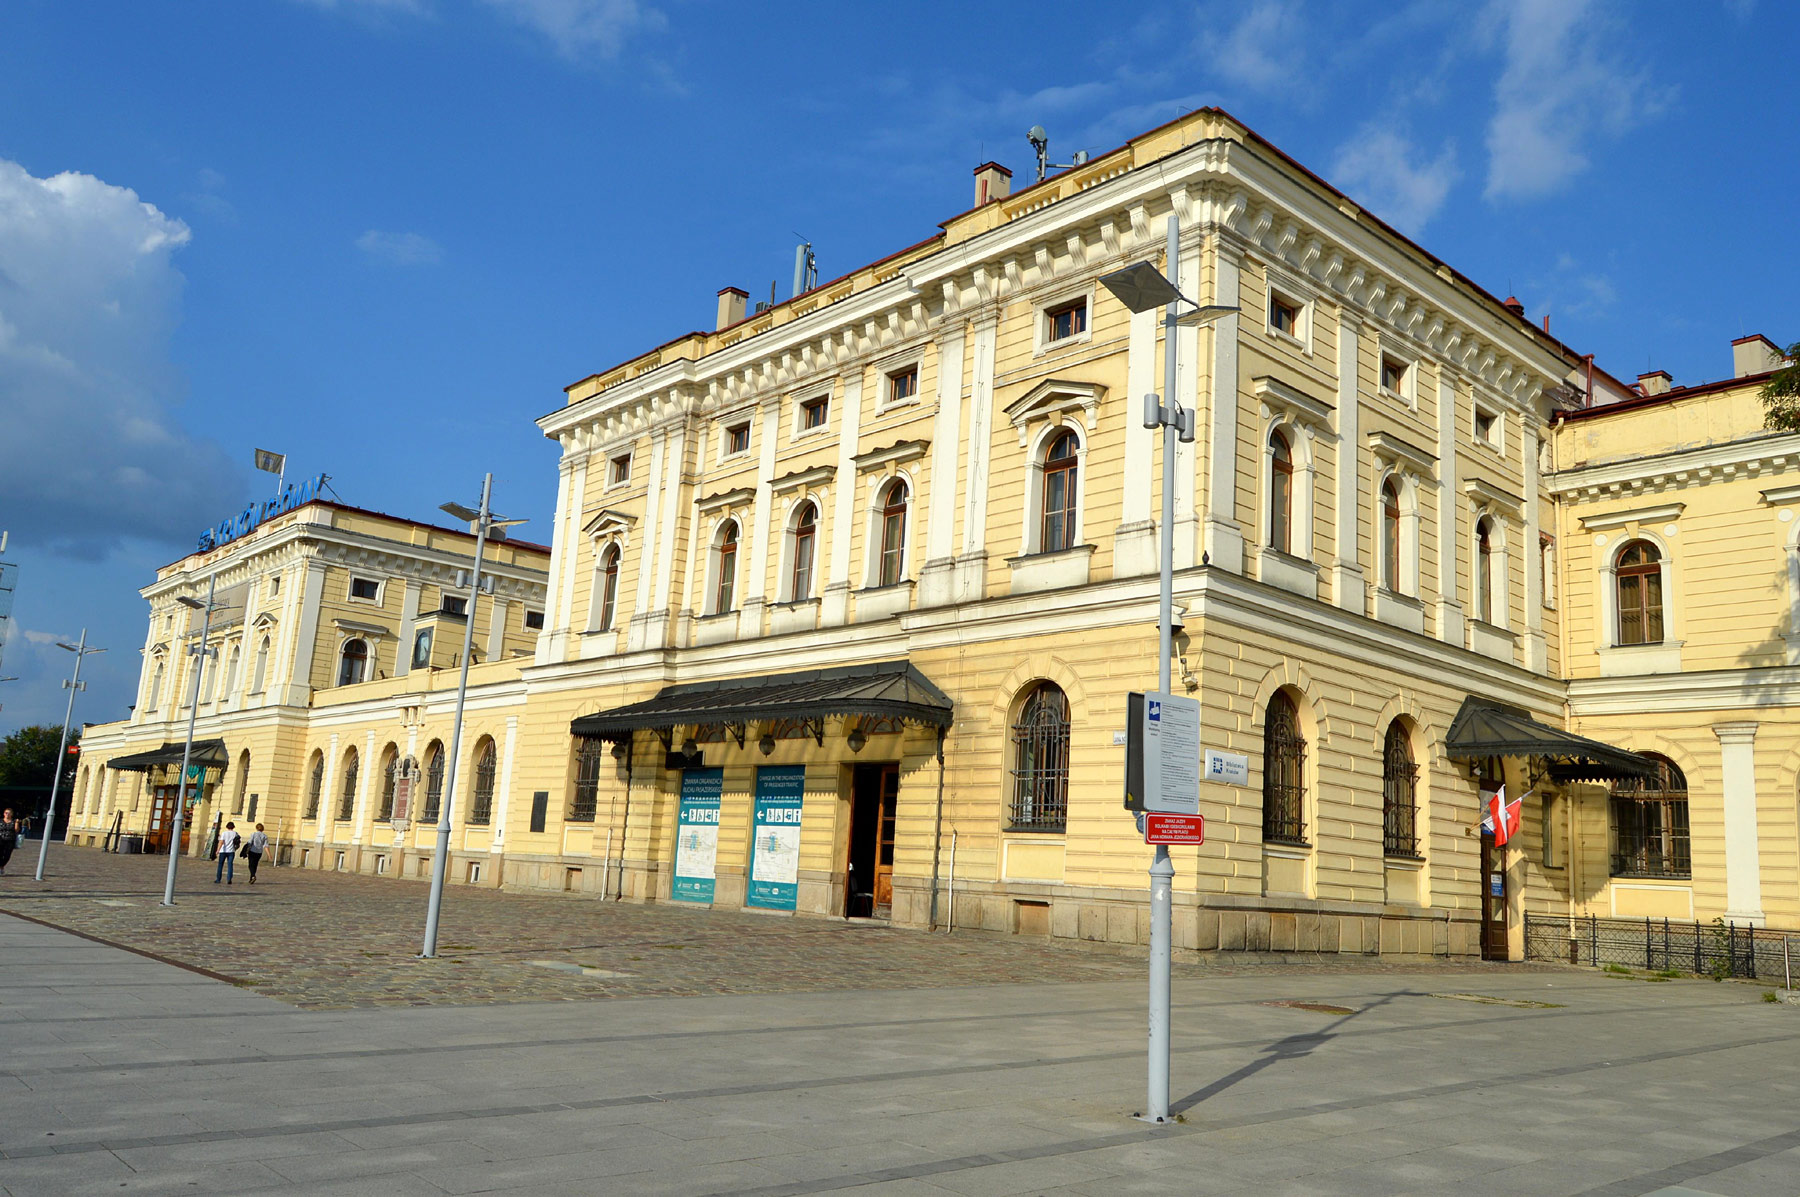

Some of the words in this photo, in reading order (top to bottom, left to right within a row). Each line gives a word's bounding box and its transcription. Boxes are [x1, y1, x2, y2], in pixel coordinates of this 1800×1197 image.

[215, 503, 265, 546] KRAKÓW
[265, 473, 323, 519] GŁÓWNY
[1226, 761, 1244, 769] Biblioteka
